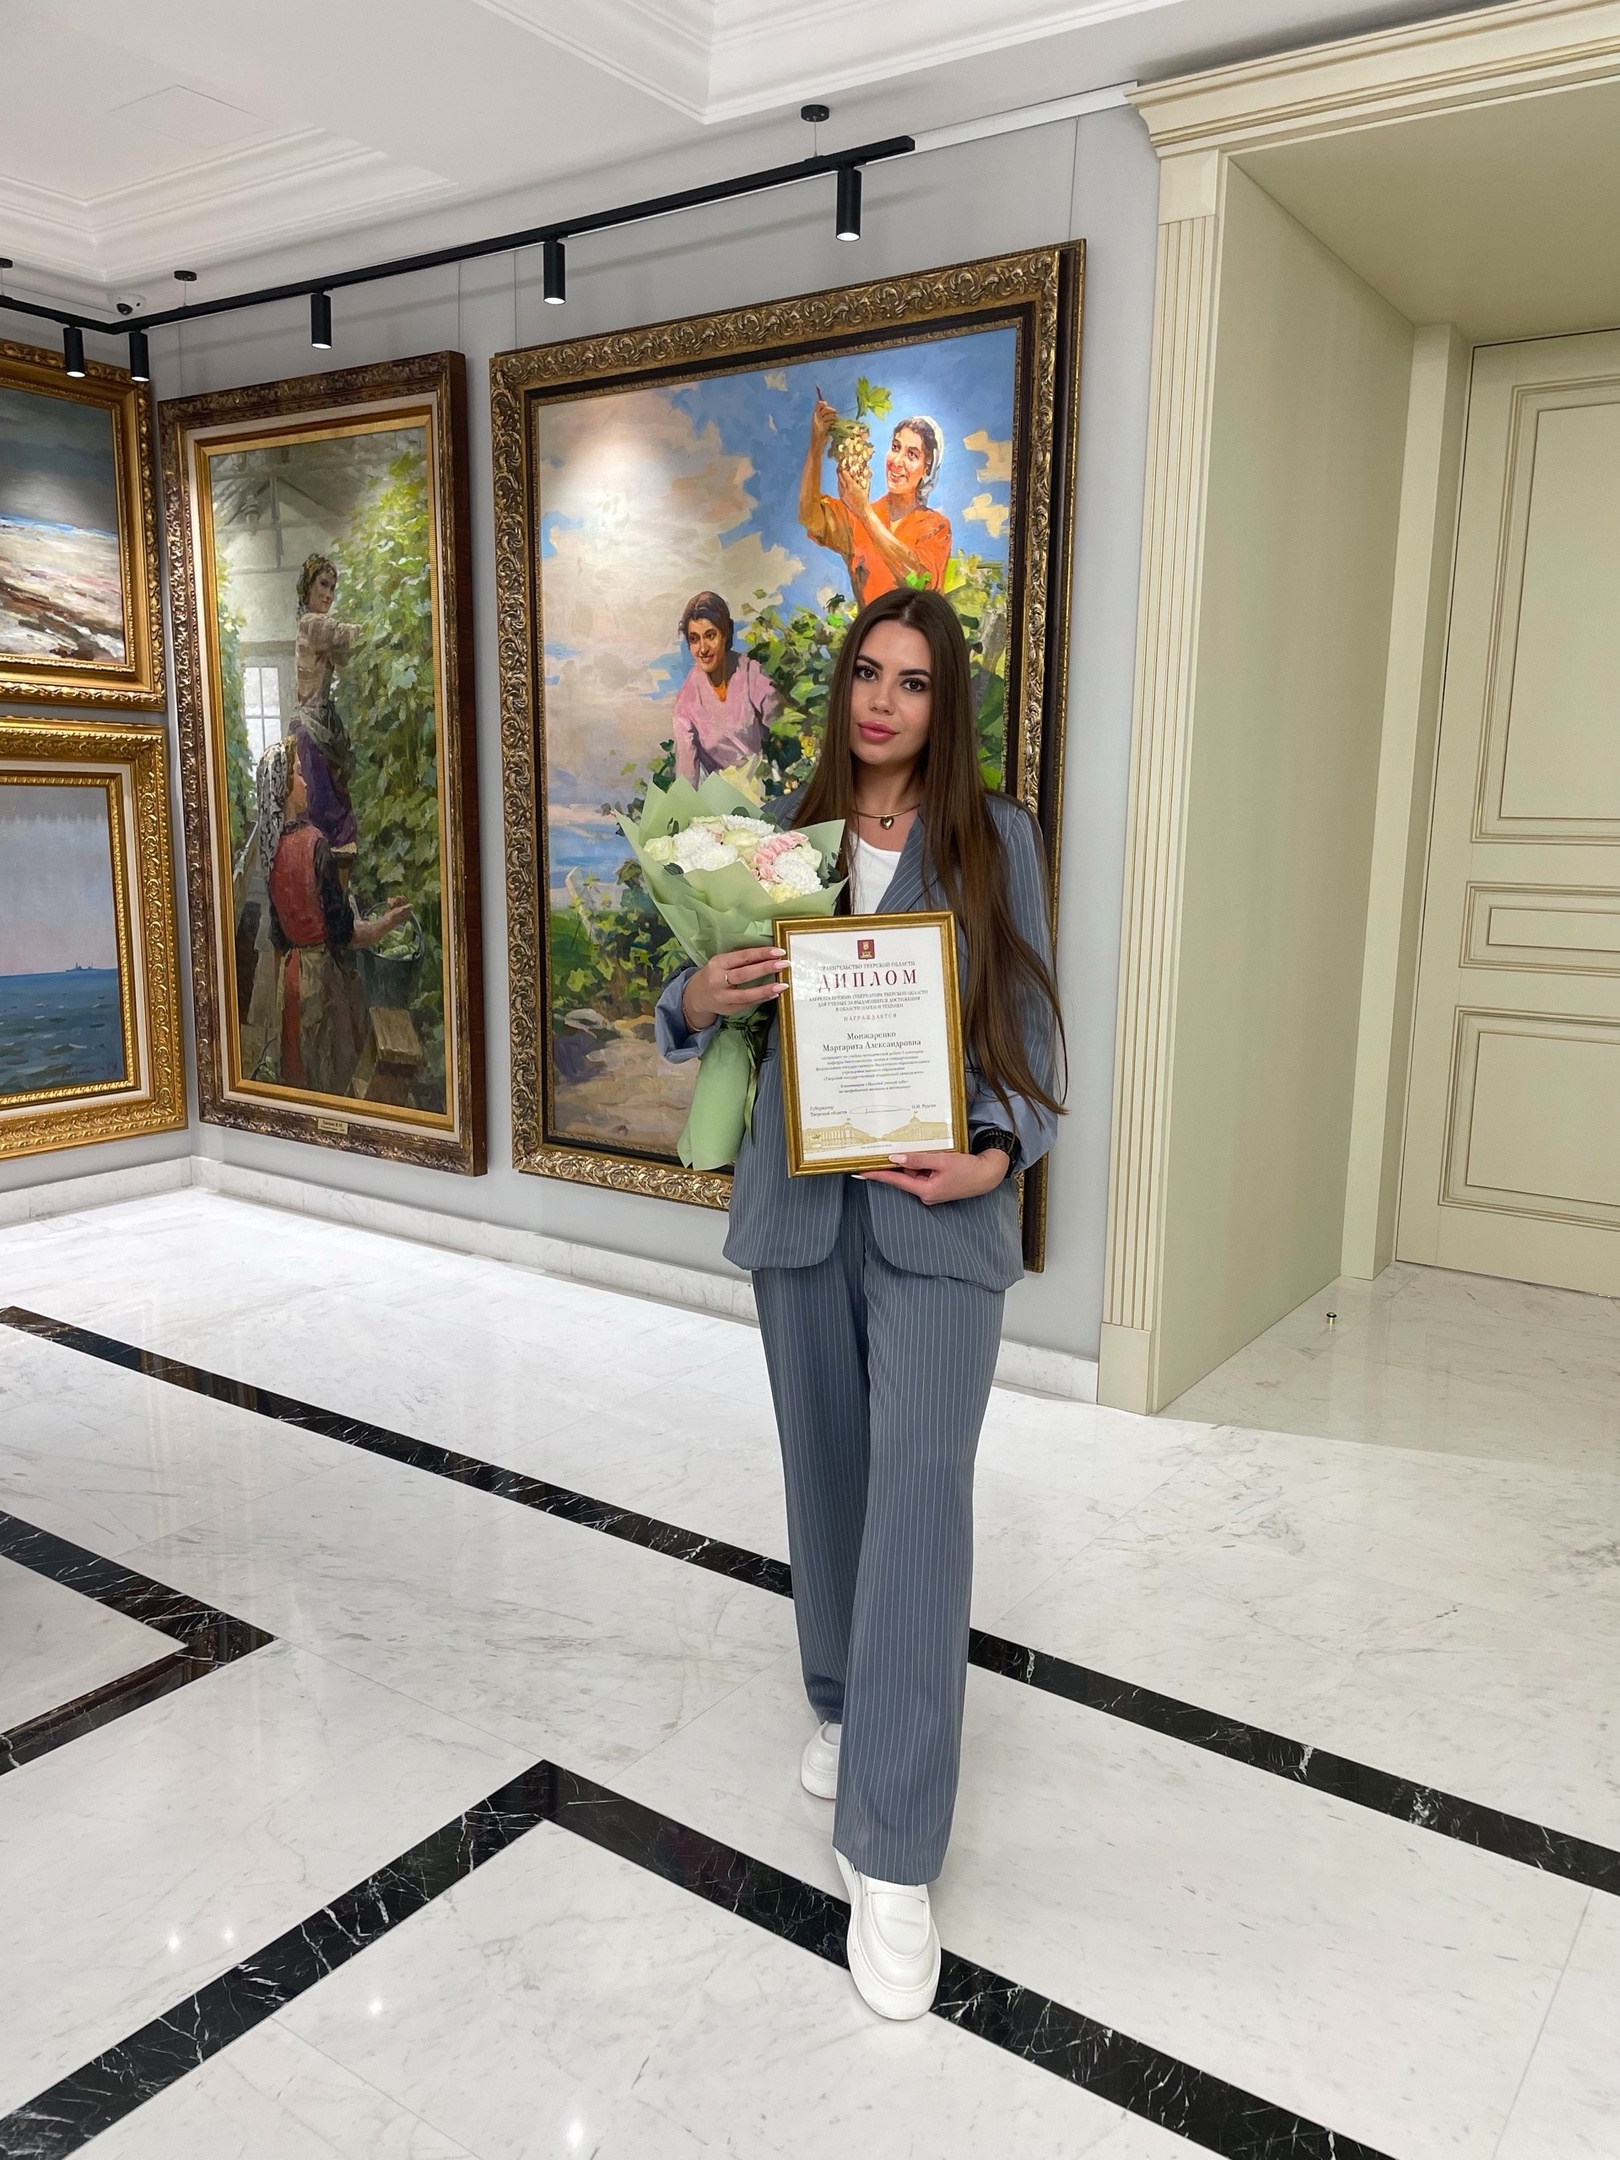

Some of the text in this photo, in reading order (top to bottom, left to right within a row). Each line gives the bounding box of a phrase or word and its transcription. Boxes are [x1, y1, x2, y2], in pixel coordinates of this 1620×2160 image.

[818, 969, 917, 993] ДИПЛОМ
[823, 1040, 921, 1053] Маргарита Александровна
